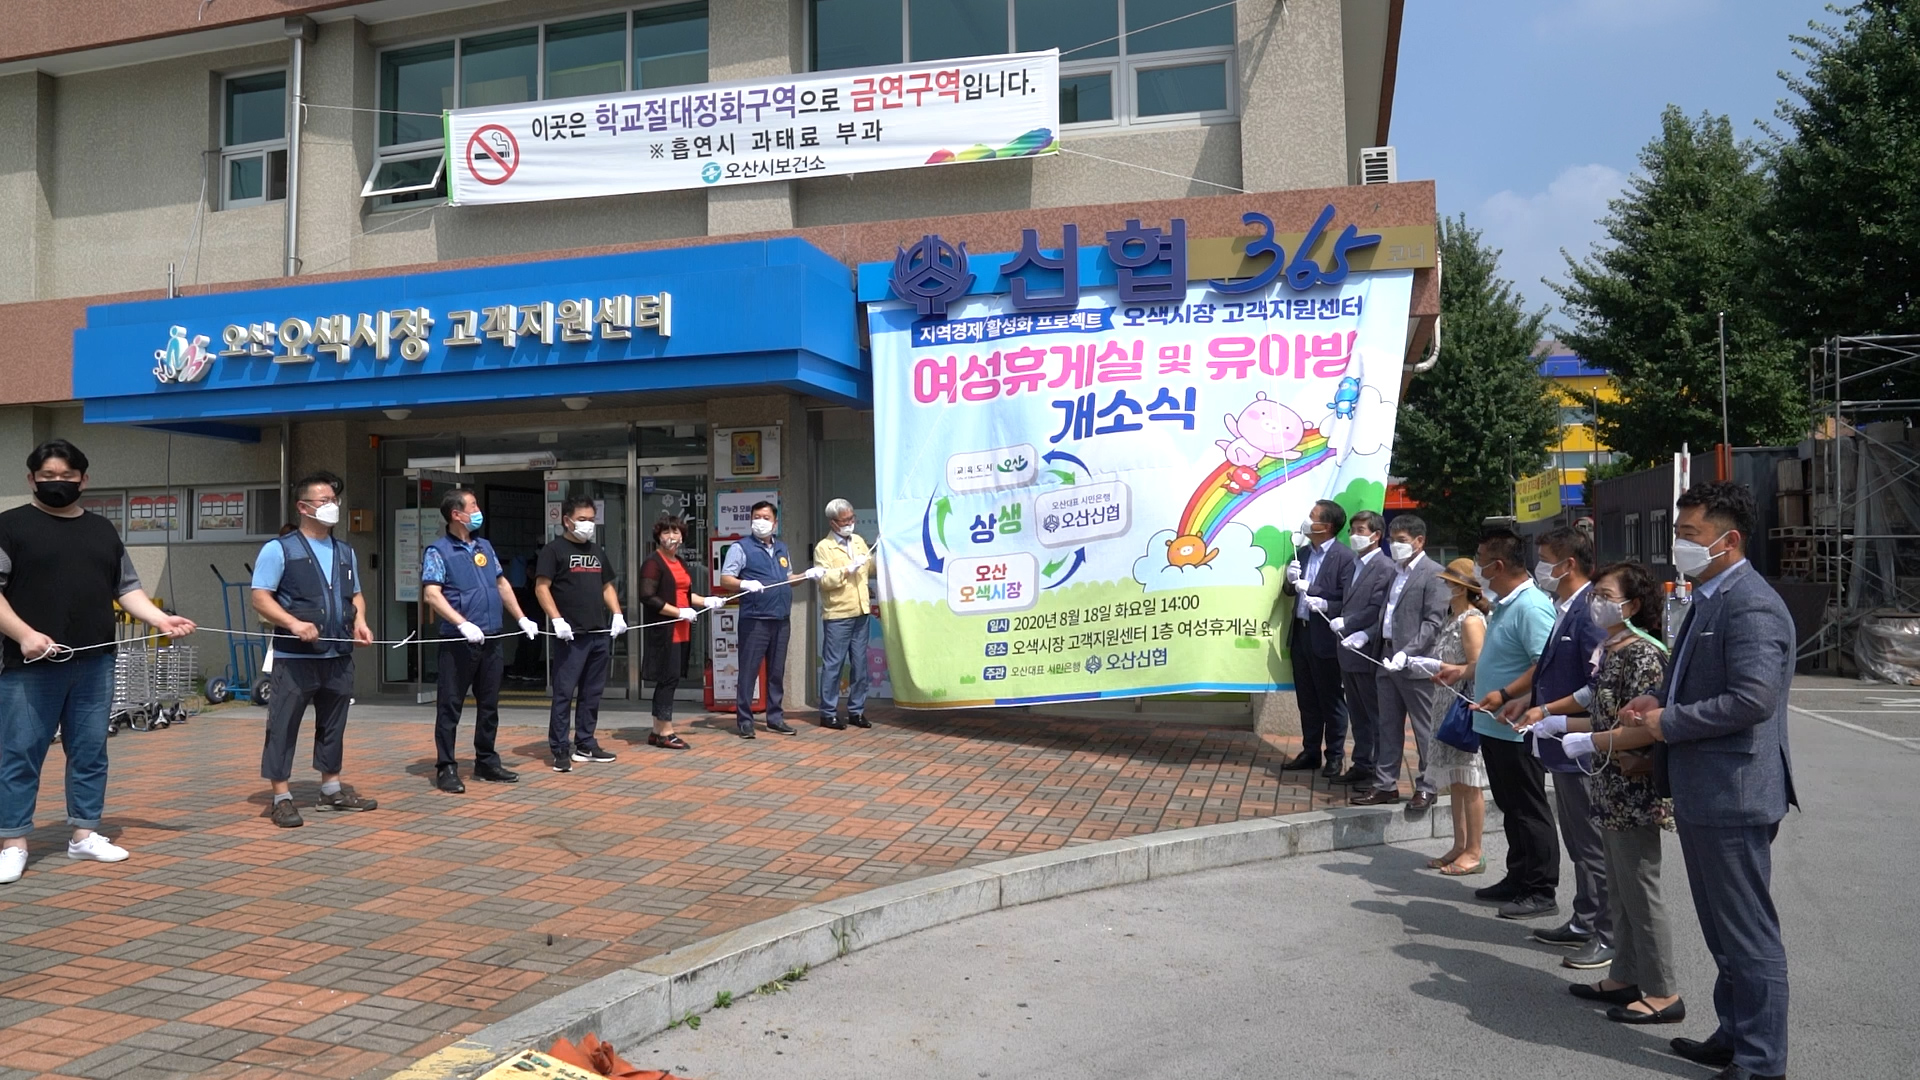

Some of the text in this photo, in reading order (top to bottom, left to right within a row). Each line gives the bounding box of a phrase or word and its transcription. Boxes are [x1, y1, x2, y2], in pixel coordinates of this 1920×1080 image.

[532, 68, 1036, 141] 이곳은 학교절대정화구역으로 금연구역입니다.
[671, 133, 735, 160] 흡연시
[752, 126, 820, 152] 과태료
[836, 119, 883, 145] 부과
[724, 155, 826, 180] 오산시보건소
[1000, 218, 1188, 309] 신협
[1208, 204, 1383, 294] 365
[443, 292, 671, 348] 고객지원센터
[1123, 295, 1363, 327] 오색시장 고객지원센터
[920, 312, 1103, 343] 지역경제 활성화 프로젝트
[914, 330, 1358, 404] 여성휴게실 및 유아방
[1049, 387, 1197, 443] 개소식
[997, 455, 1028, 473] 오산
[1052, 493, 1111, 510] 오산대표 시민은행
[1061, 503, 1120, 529] 오산신협
[969, 502, 1022, 544] 상생
[569, 554, 602, 569] FILA
[975, 563, 1007, 582] 오산
[960, 581, 1022, 603] 오색시장
[989, 594, 1200, 632] 일시 2020년 8월 18일 화요일 14:00
[987, 643, 1007, 656] 장소
[1012, 635, 1065, 655] 오색시장
[1067, 625, 1147, 650] 고객지원센터
[1151, 622, 1174, 641] 1층
[1178, 618, 1257, 638] 여성휴게실
[985, 648, 1167, 680] 주관 오산대표 시민은행 오산신협
